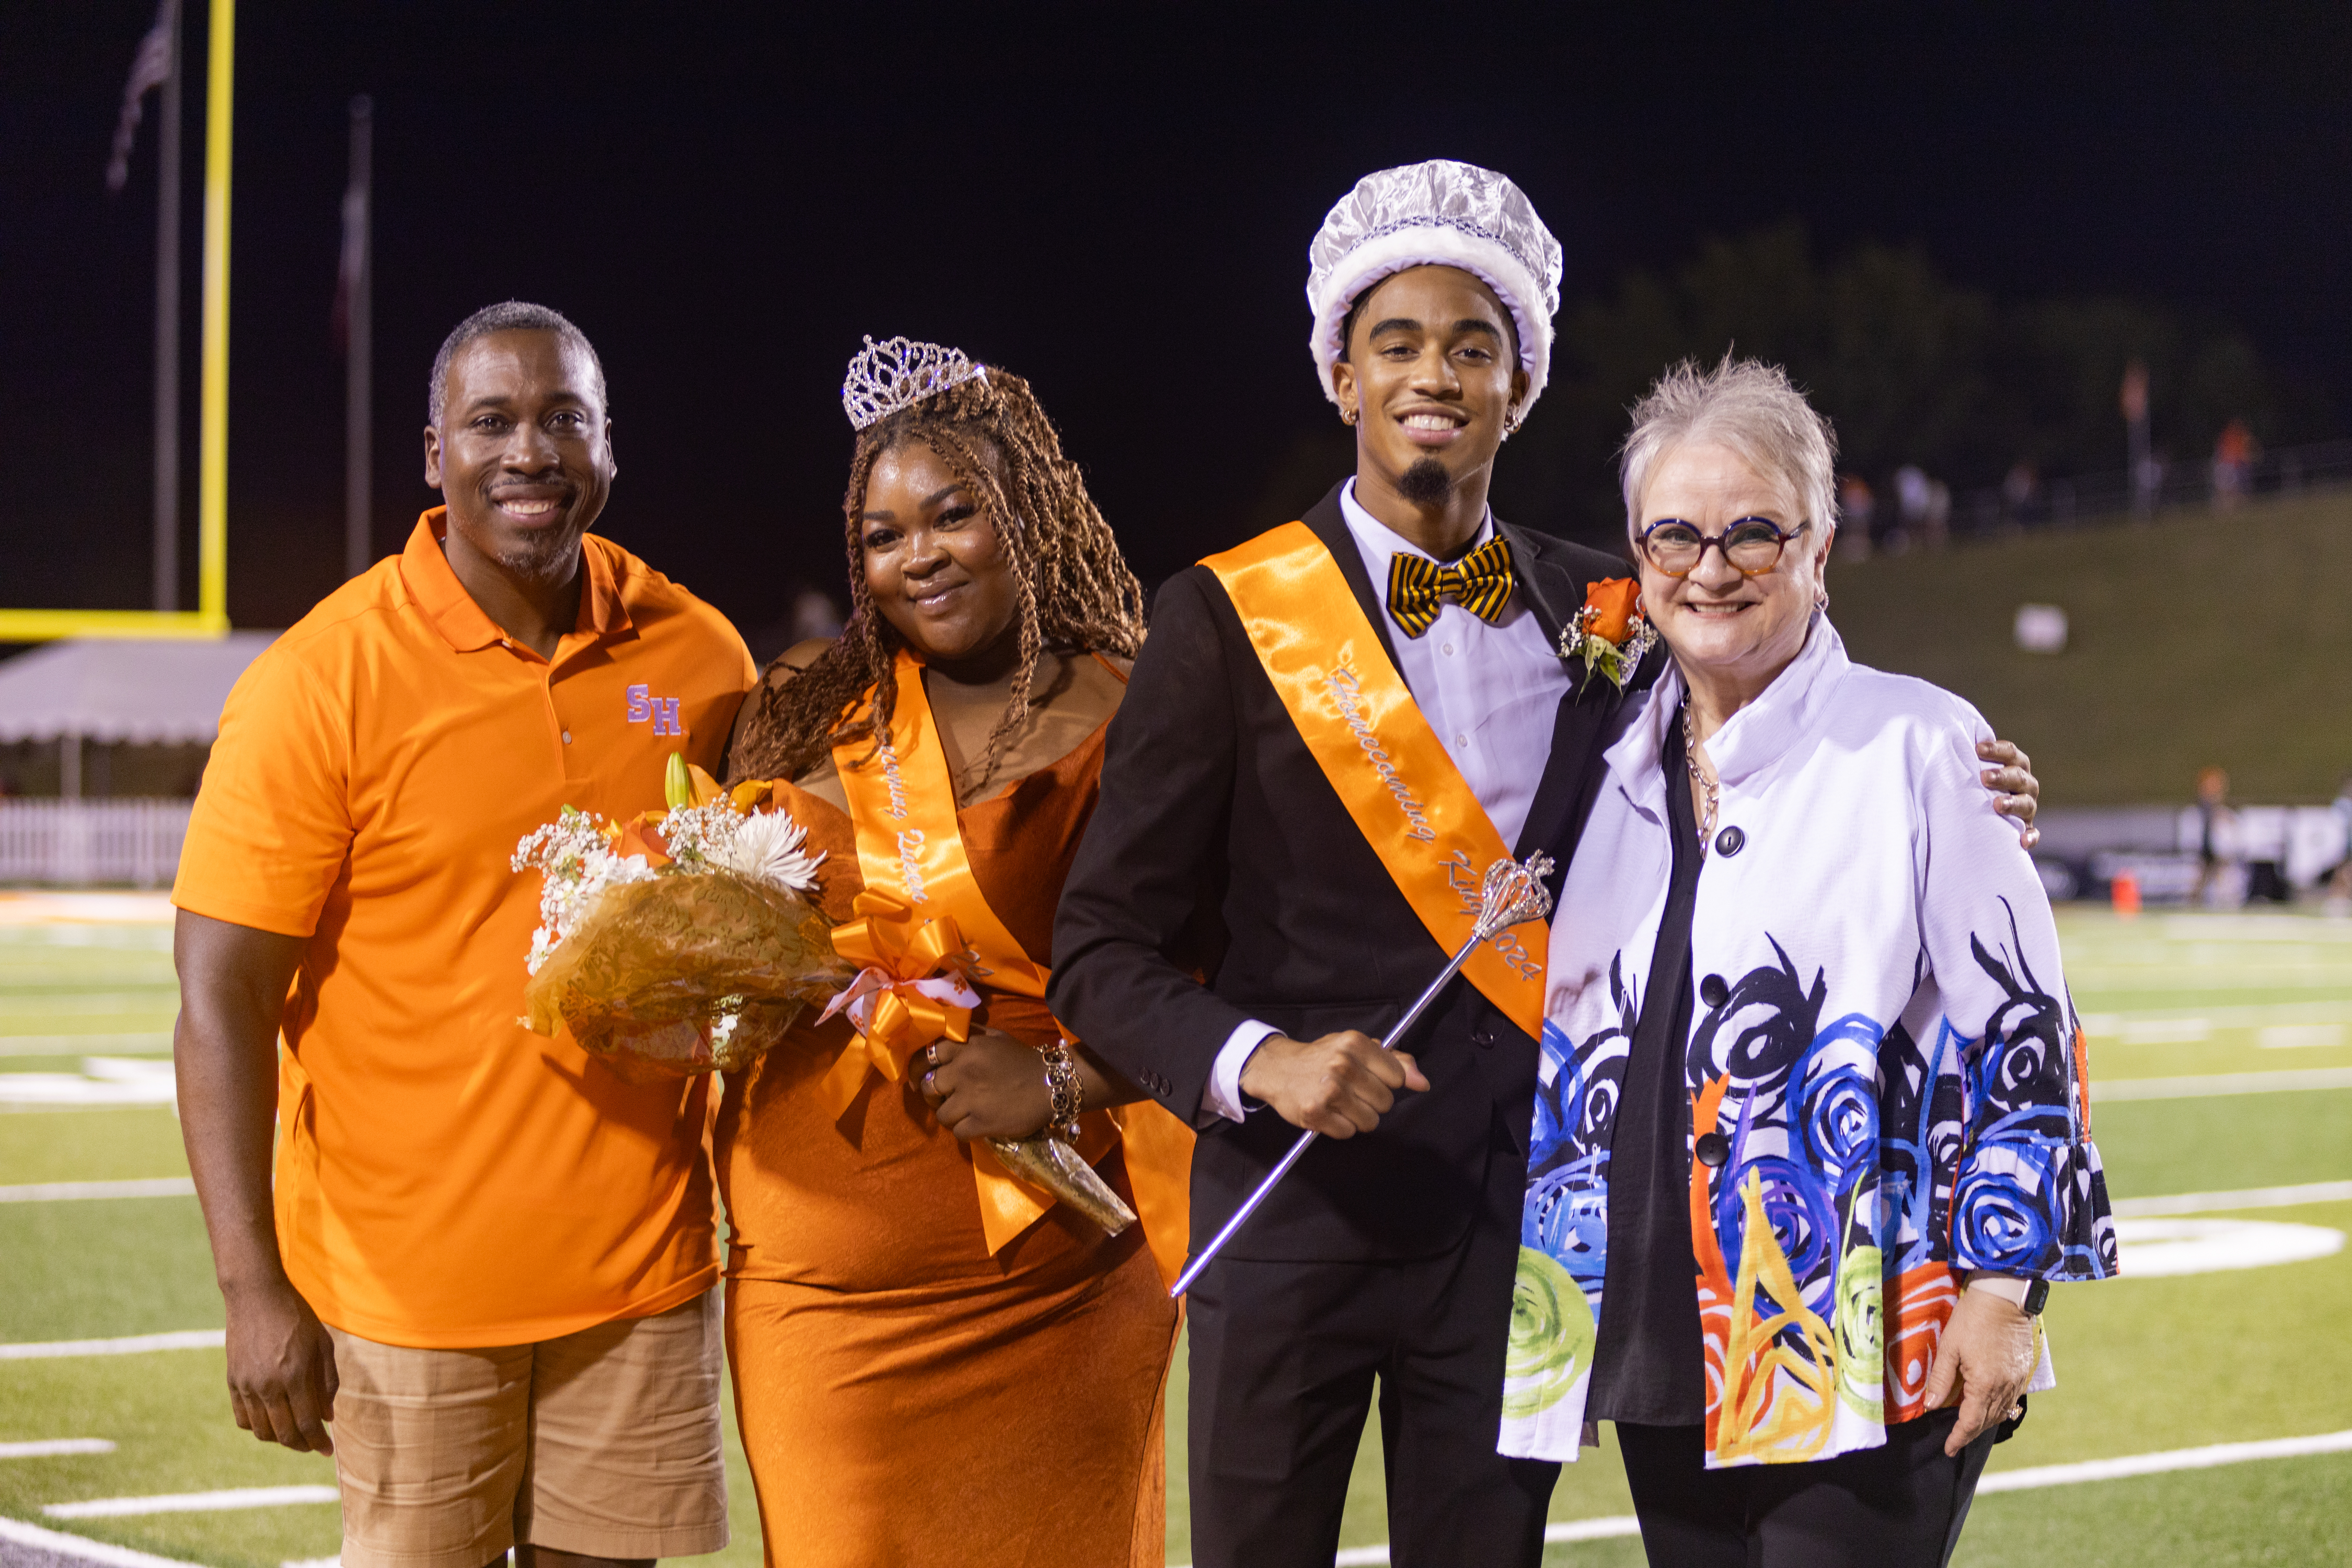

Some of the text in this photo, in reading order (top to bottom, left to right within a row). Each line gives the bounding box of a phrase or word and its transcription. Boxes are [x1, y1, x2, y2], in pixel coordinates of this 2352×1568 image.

[627, 684, 681, 735] SH
[879, 728, 908, 821] ecoming
[897, 828, 928, 905] Queen
[1325, 668, 1436, 845] Homecoming
[1495, 933, 1542, 982] 024
